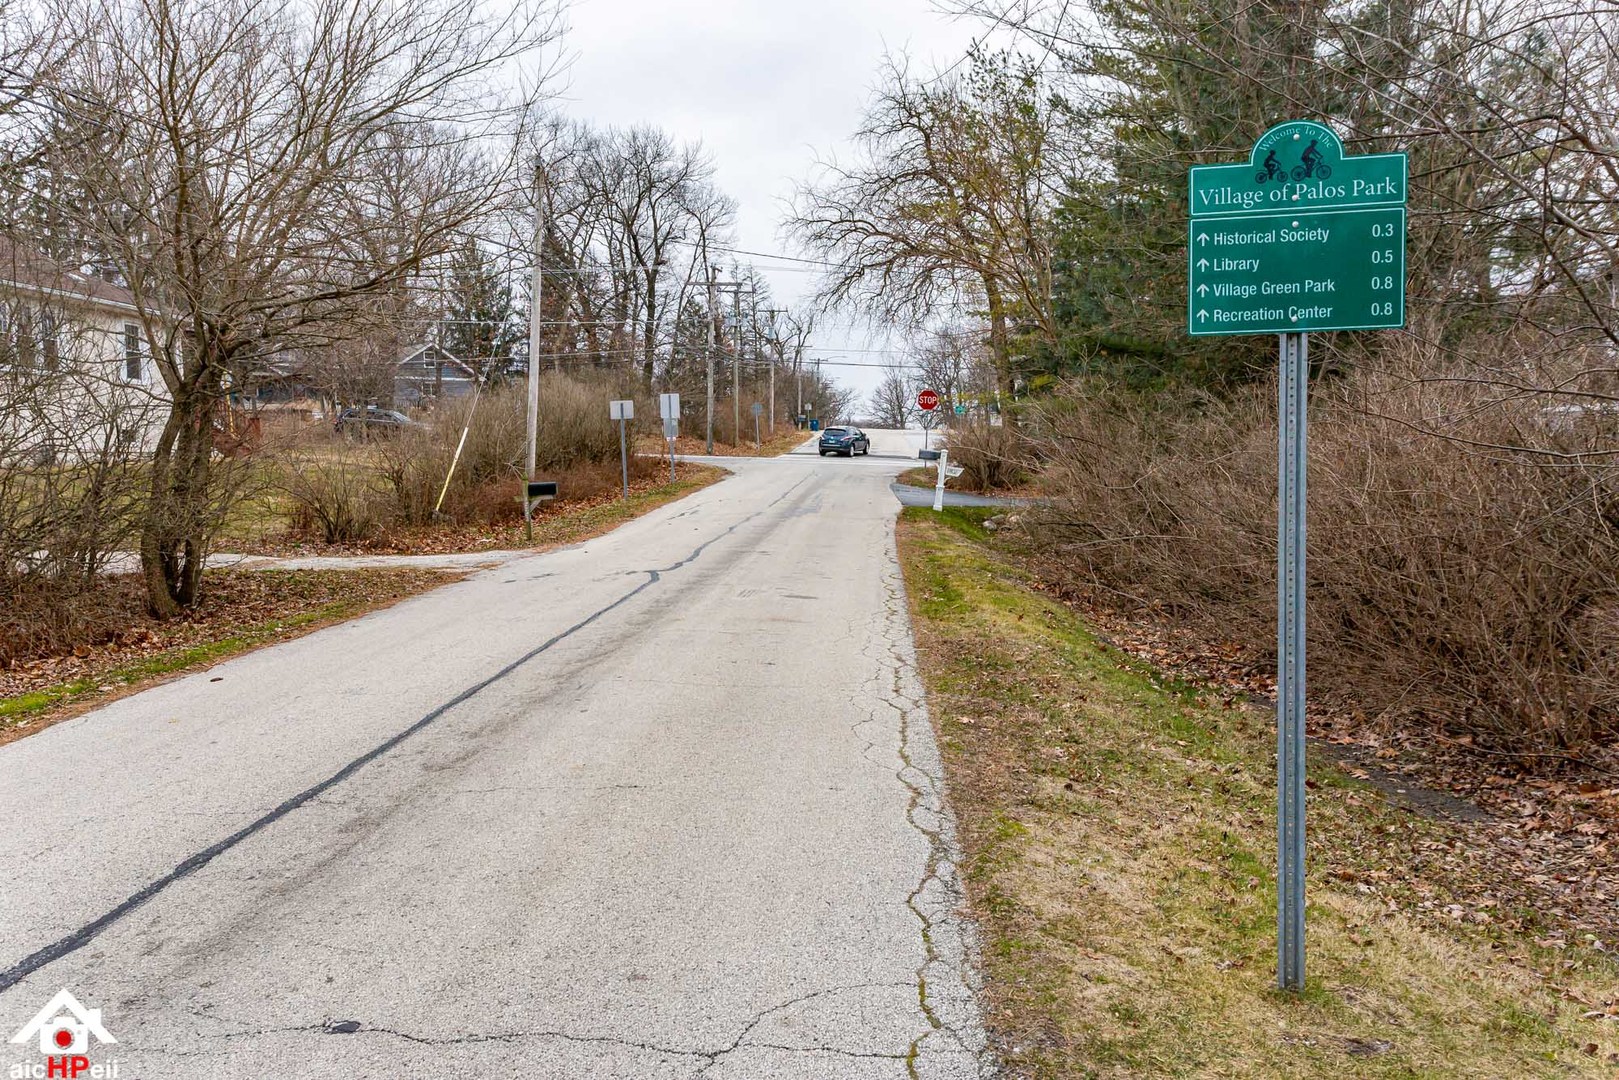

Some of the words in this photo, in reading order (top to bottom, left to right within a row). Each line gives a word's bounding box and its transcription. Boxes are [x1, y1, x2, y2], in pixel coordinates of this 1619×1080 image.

[1259, 127, 1300, 151] Welcome
[1304, 126, 1316, 136] To
[1318, 131, 1333, 149] The
[1199, 187, 1263, 208] Village
[1270, 183, 1291, 201] of
[1294, 181, 1345, 200] Palos
[1352, 177, 1397, 197] Park
[1214, 230, 1276, 245] Historical
[1280, 228, 1329, 243] Society
[1372, 223, 1394, 238] 0.3
[1213, 258, 1260, 273] Library
[1371, 250, 1393, 264] 0.5
[1213, 282, 1257, 298] Village
[1261, 281, 1300, 295] Green
[1305, 279, 1335, 293] Park
[1371, 276, 1393, 290] 0.8
[1213, 307, 1284, 323] Recreation
[1288, 306, 1333, 321] Center
[1371, 303, 1393, 316] 0.8
[919, 396, 937, 405] STOP
